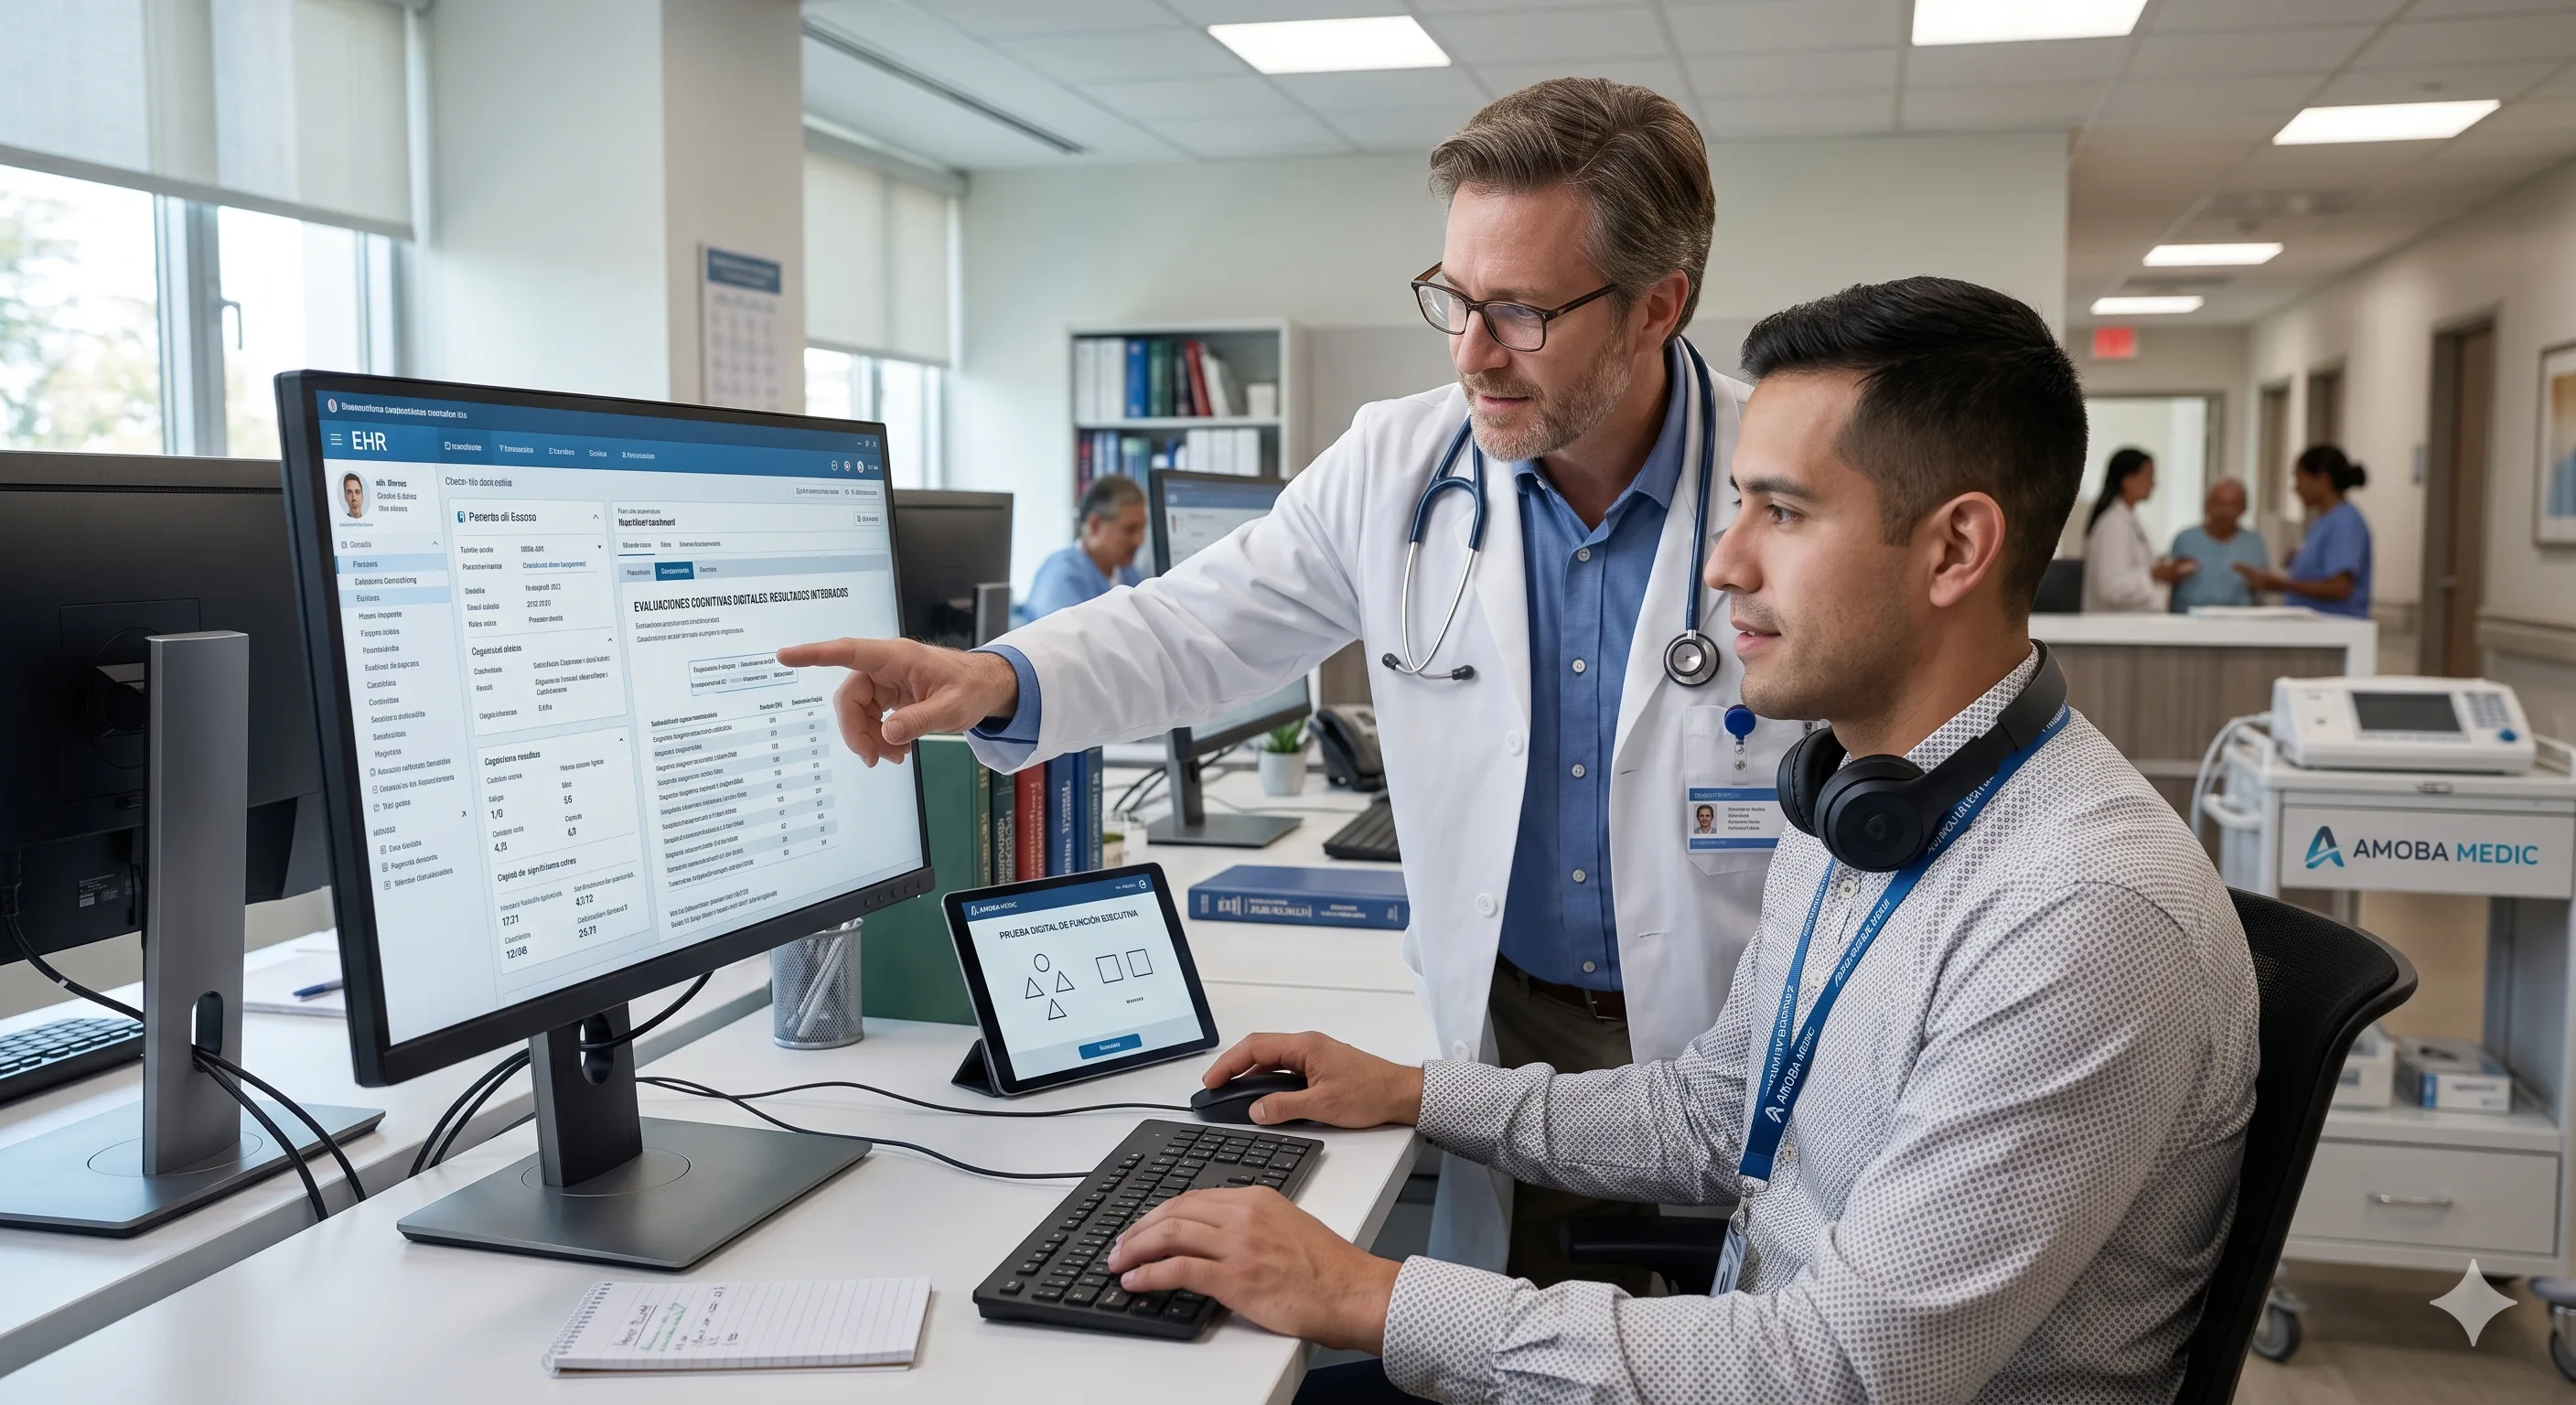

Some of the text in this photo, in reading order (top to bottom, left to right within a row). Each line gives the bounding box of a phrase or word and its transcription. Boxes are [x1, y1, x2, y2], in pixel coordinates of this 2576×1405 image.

[352, 431, 387, 451] EHR
[634, 598, 690, 612] EVALUACIONES
[692, 595, 732, 607] COGNITIVAS
[2353, 839, 2538, 865] AMOBA MEDIC
[999, 928, 1030, 939] PRUEBA
[1031, 924, 1058, 934] DIGITAL
[1058, 921, 1068, 929] DE
